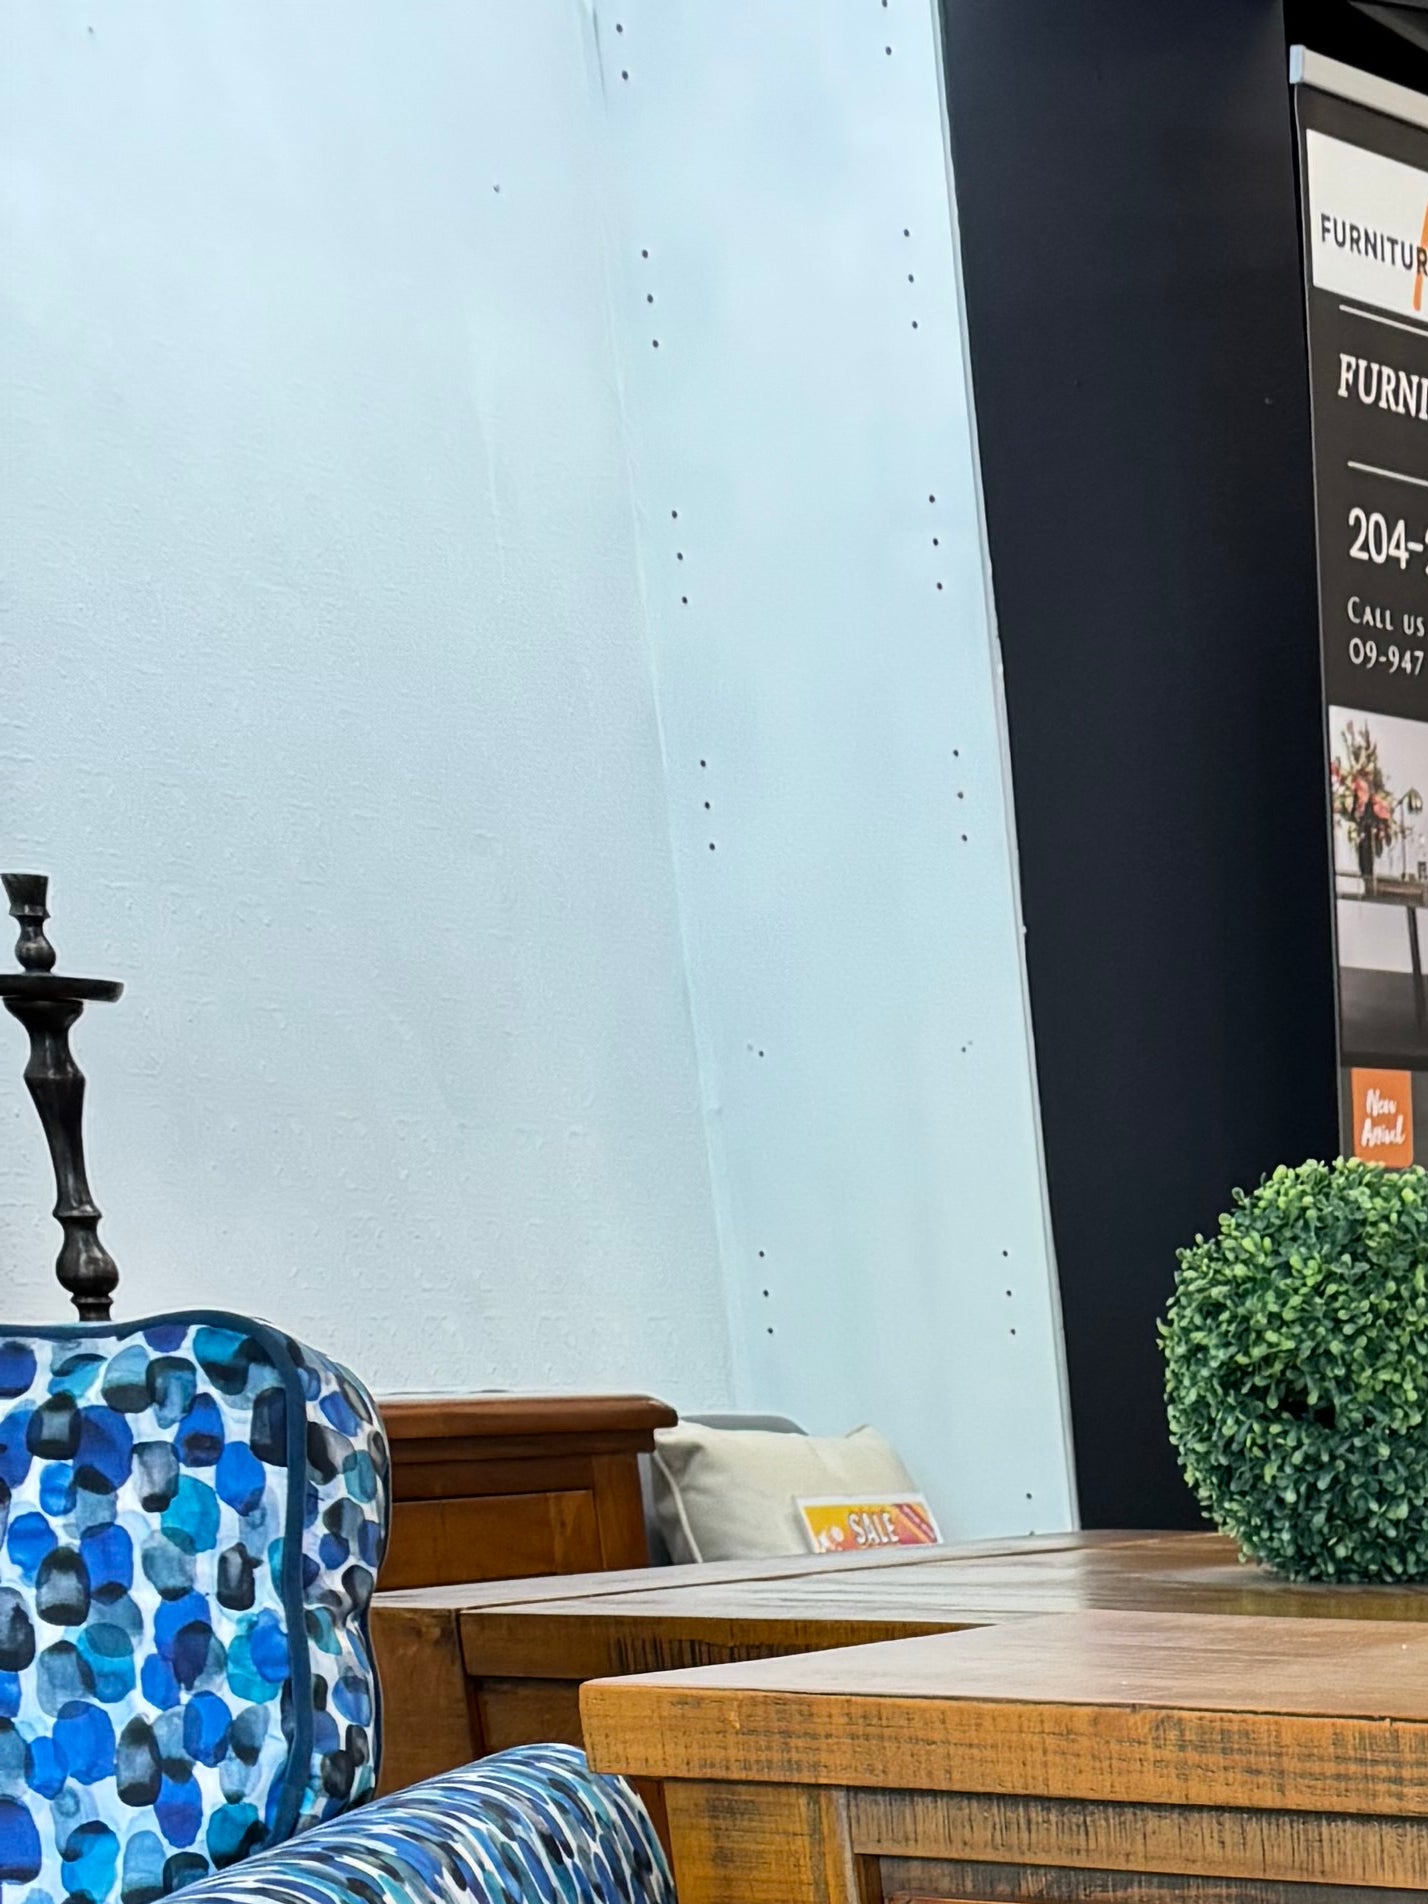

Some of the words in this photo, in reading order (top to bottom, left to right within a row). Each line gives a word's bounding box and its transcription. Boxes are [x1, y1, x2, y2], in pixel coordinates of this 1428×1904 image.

[1348, 637, 1424, 676] 09-947
[1366, 1088, 1397, 1117] New
[848, 1511, 900, 1545] SALE
